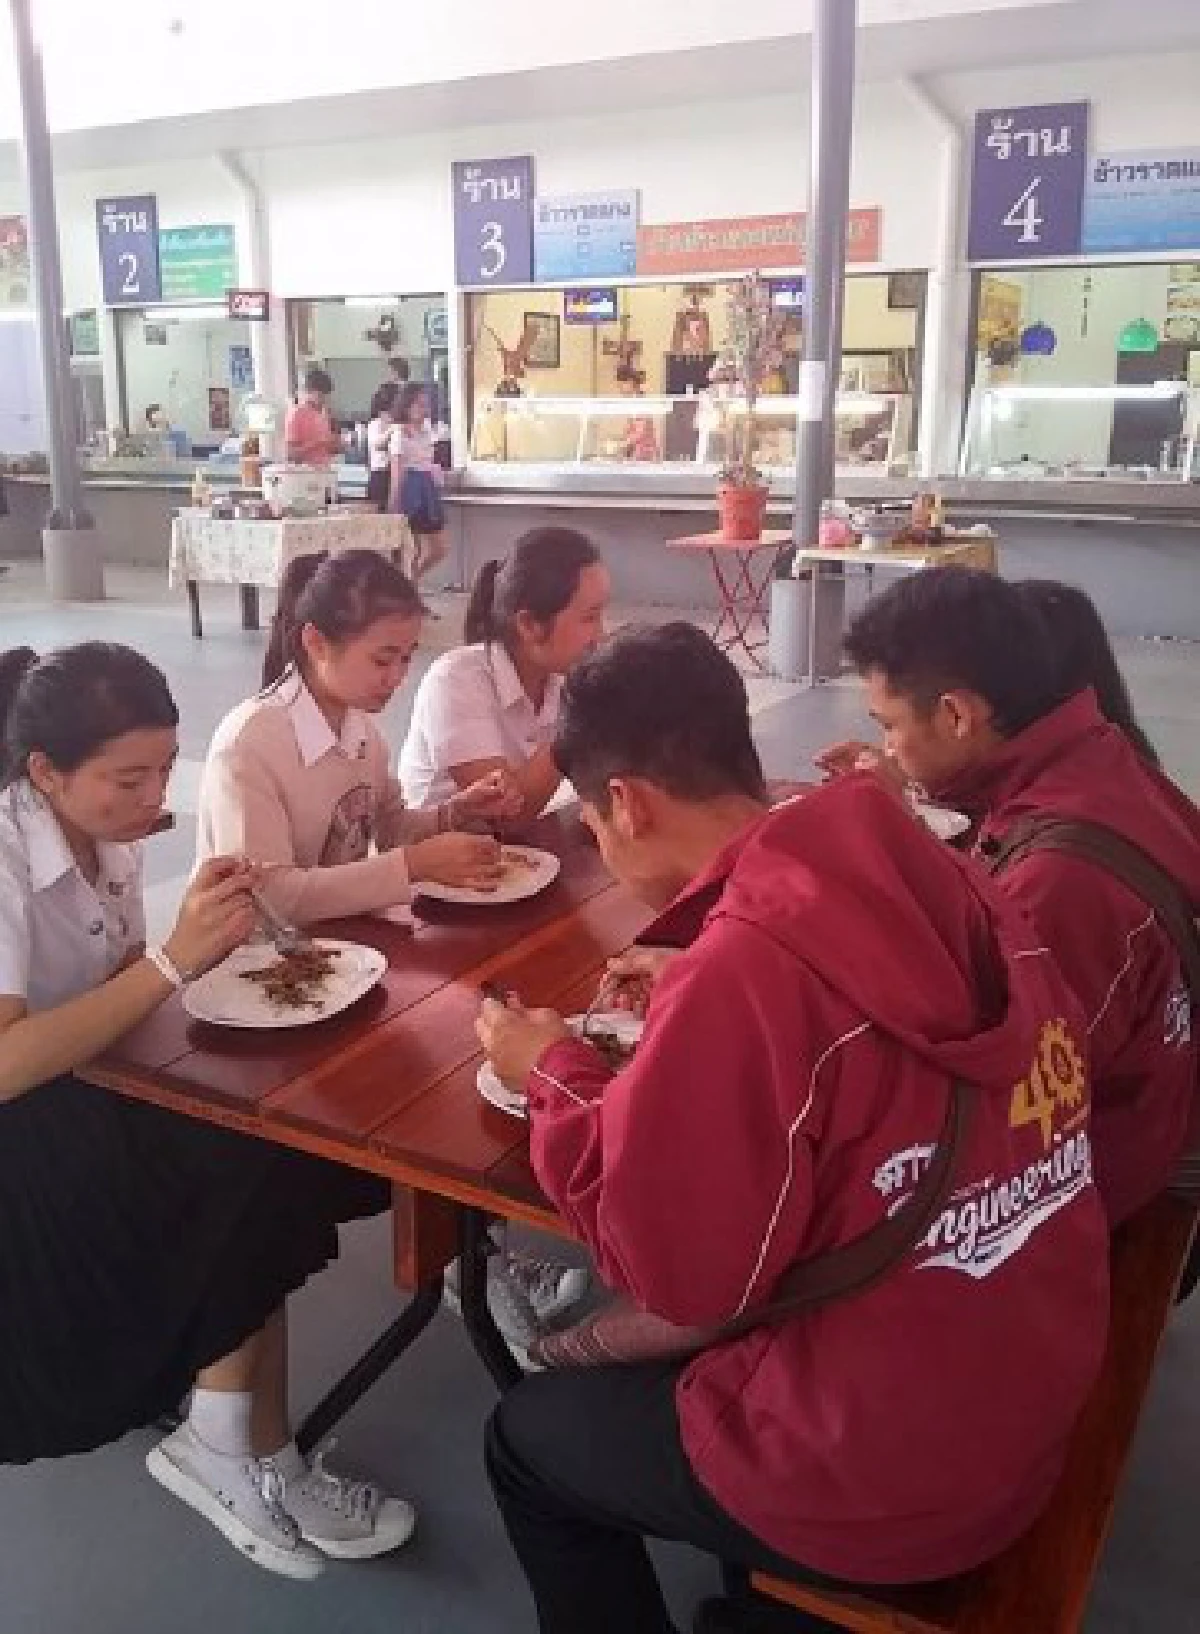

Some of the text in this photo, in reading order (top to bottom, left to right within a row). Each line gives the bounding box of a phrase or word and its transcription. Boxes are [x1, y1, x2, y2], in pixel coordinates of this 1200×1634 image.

[985, 117, 1072, 160] ร้าน
[461, 167, 521, 203] ร้าน
[1093, 158, 1200, 183] ข้าวราดแ
[102, 204, 147, 233] ร้าน
[1001, 175, 1045, 243] 4
[480, 221, 506, 277] 3
[118, 251, 140, 294] 2
[911, 1129, 1093, 1260] ngineering
